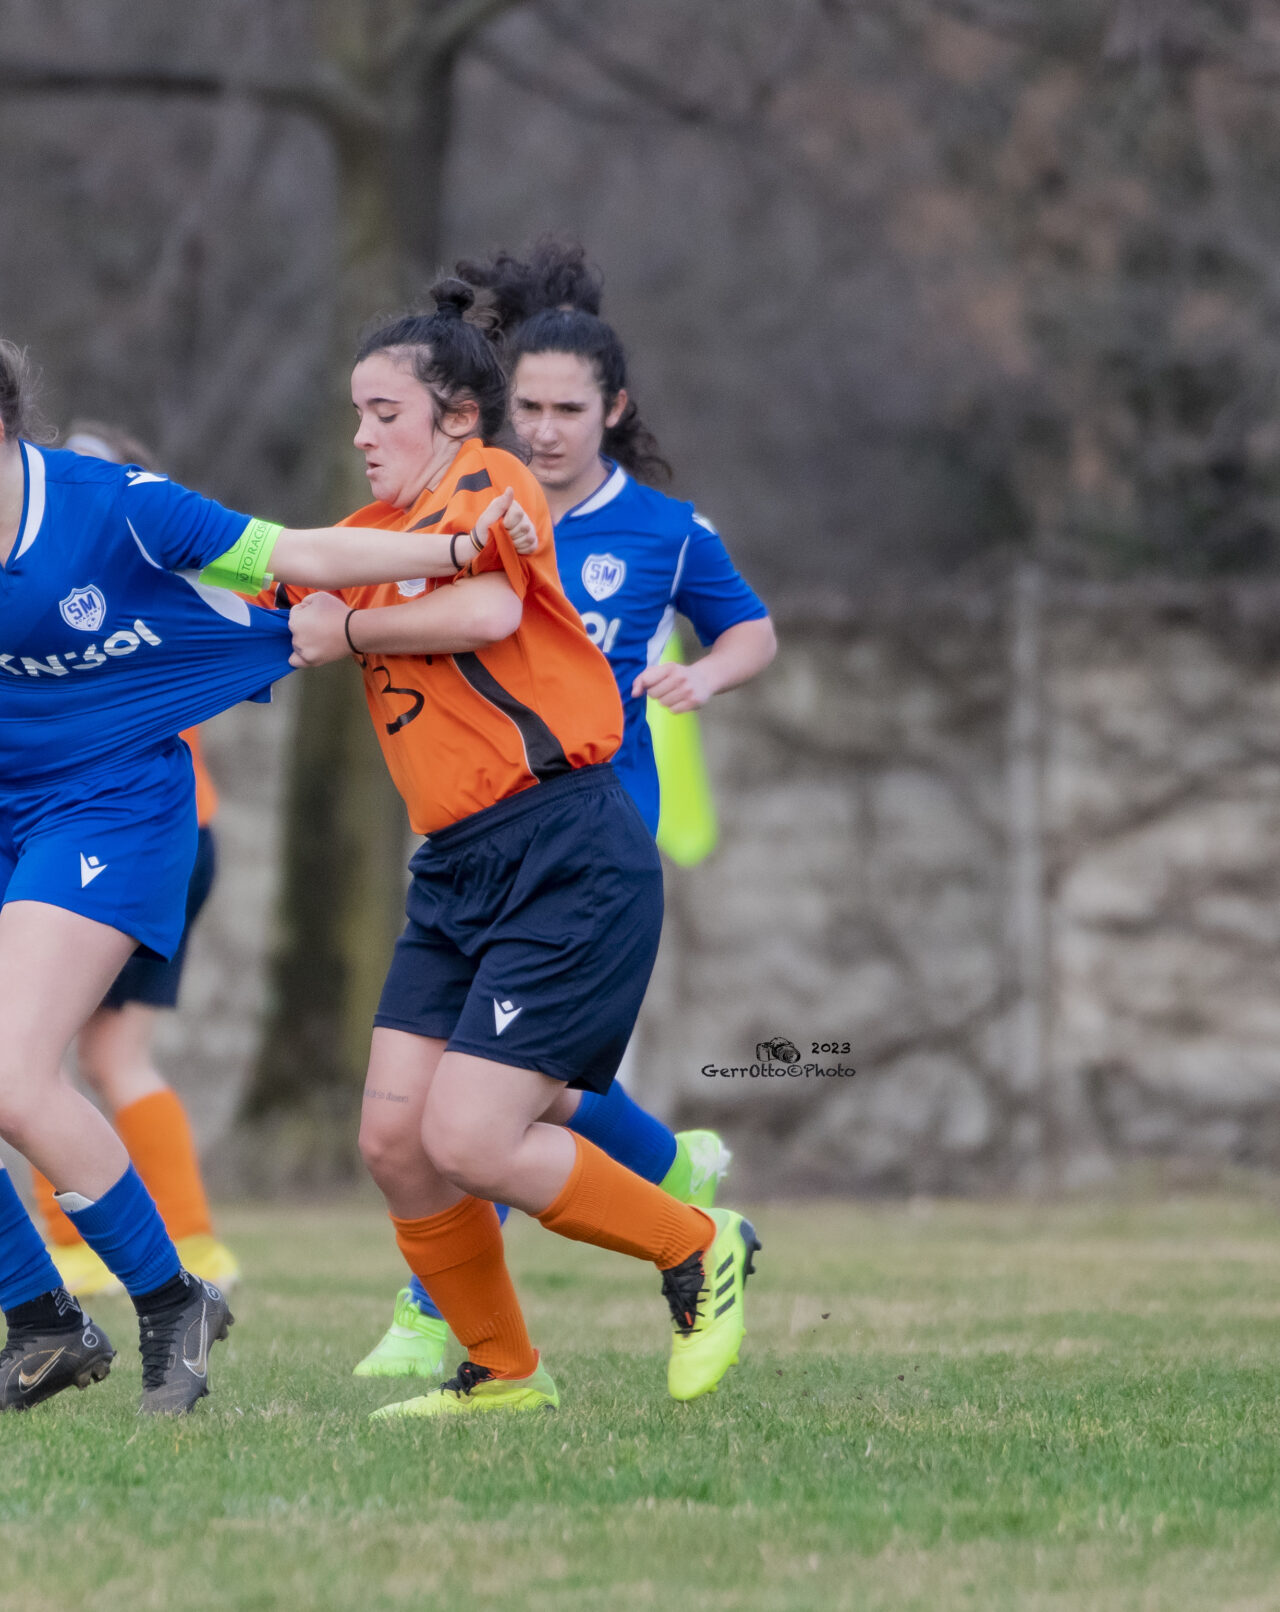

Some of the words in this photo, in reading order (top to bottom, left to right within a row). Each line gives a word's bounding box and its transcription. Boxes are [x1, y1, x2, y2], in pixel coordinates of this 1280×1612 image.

[241, 556, 254, 571] TO
[591, 563, 618, 585] SM
[67, 593, 97, 620] SM
